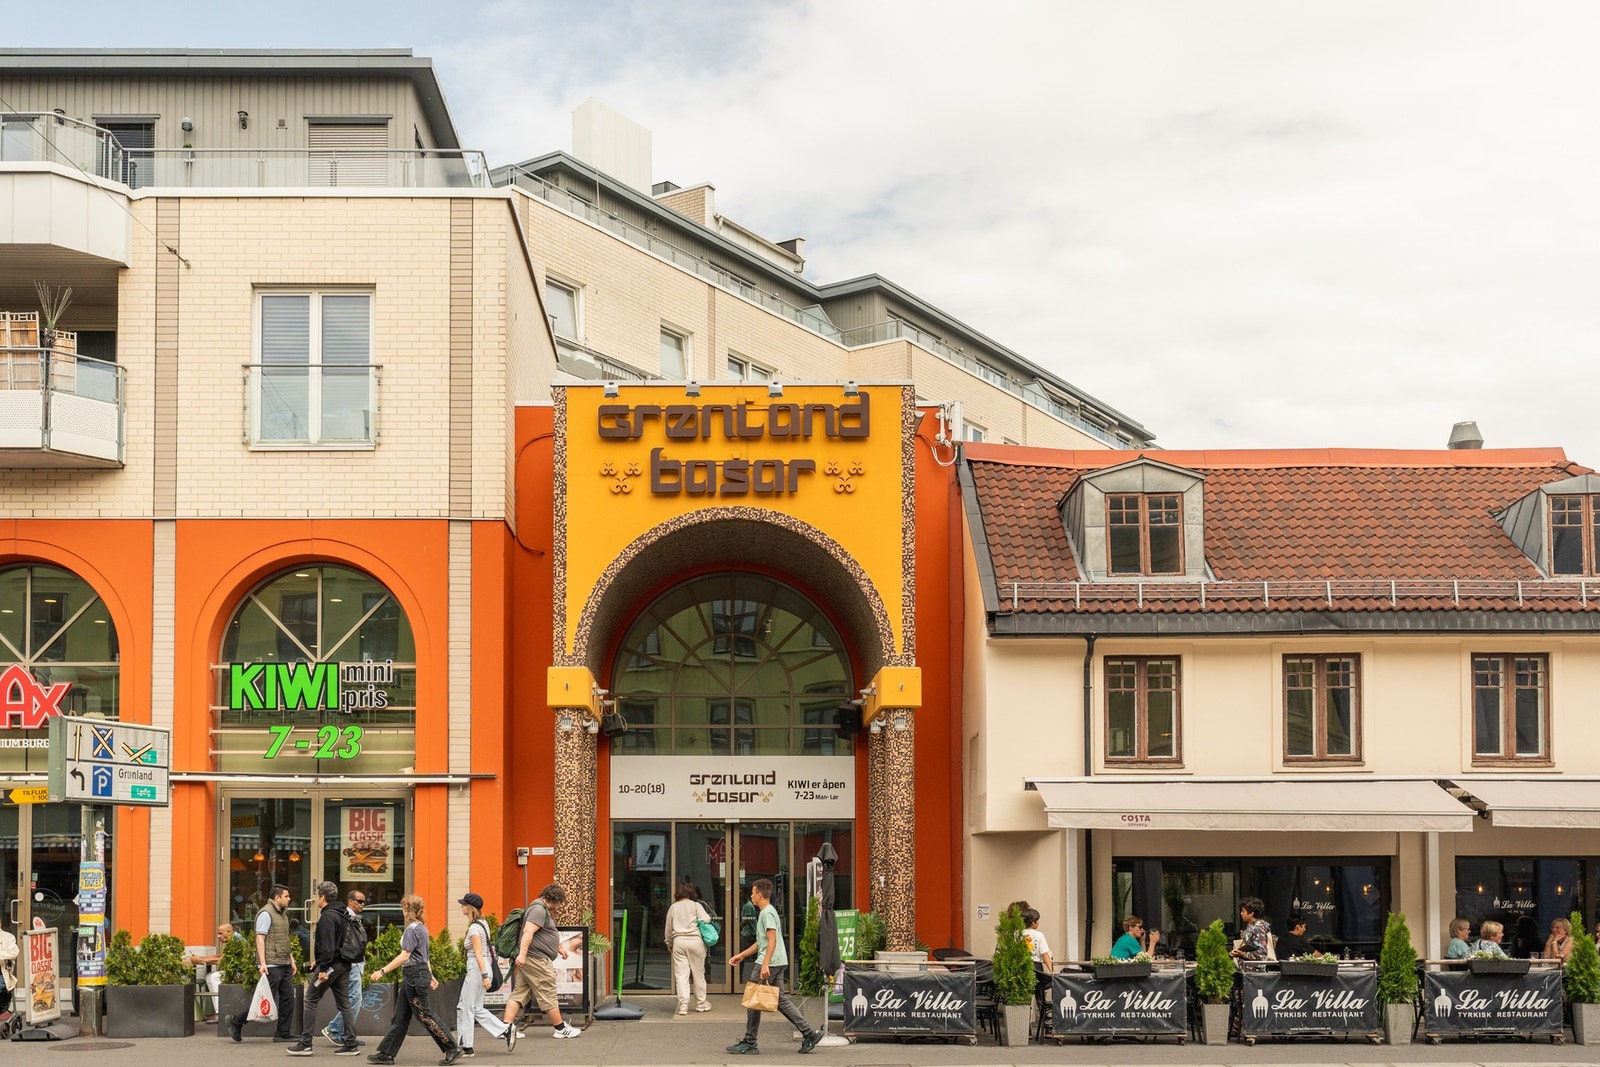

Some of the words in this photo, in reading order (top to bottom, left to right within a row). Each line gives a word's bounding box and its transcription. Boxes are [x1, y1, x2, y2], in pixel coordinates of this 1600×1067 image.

[598, 391, 871, 439] Grønland
[650, 447, 816, 496] basar
[344, 658, 393, 683] mini
[229, 662, 340, 711] KIWI
[344, 683, 388, 713] pris
[690, 770, 776, 785] Grønland
[787, 780, 811, 789] KIWI
[822, 778, 846, 790] åpen
[706, 788, 759, 803] basar
[794, 791, 814, 800] 7-23
[349, 808, 386, 831] BIG
[1300, 901, 1314, 910] La
[1315, 901, 1336, 910] Villa
[1500, 900, 1514, 909] La
[1515, 900, 1536, 909] Villa
[30, 932, 53, 962] BIG
[870, 989, 907, 1009] La
[910, 990, 967, 1011] Villa
[1080, 990, 1116, 1010] La
[1118, 990, 1177, 1010] Villa
[1271, 989, 1308, 1010] La
[1310, 989, 1369, 1010] Villa
[1455, 989, 1492, 1010] La
[1495, 989, 1554, 1010] Villa
